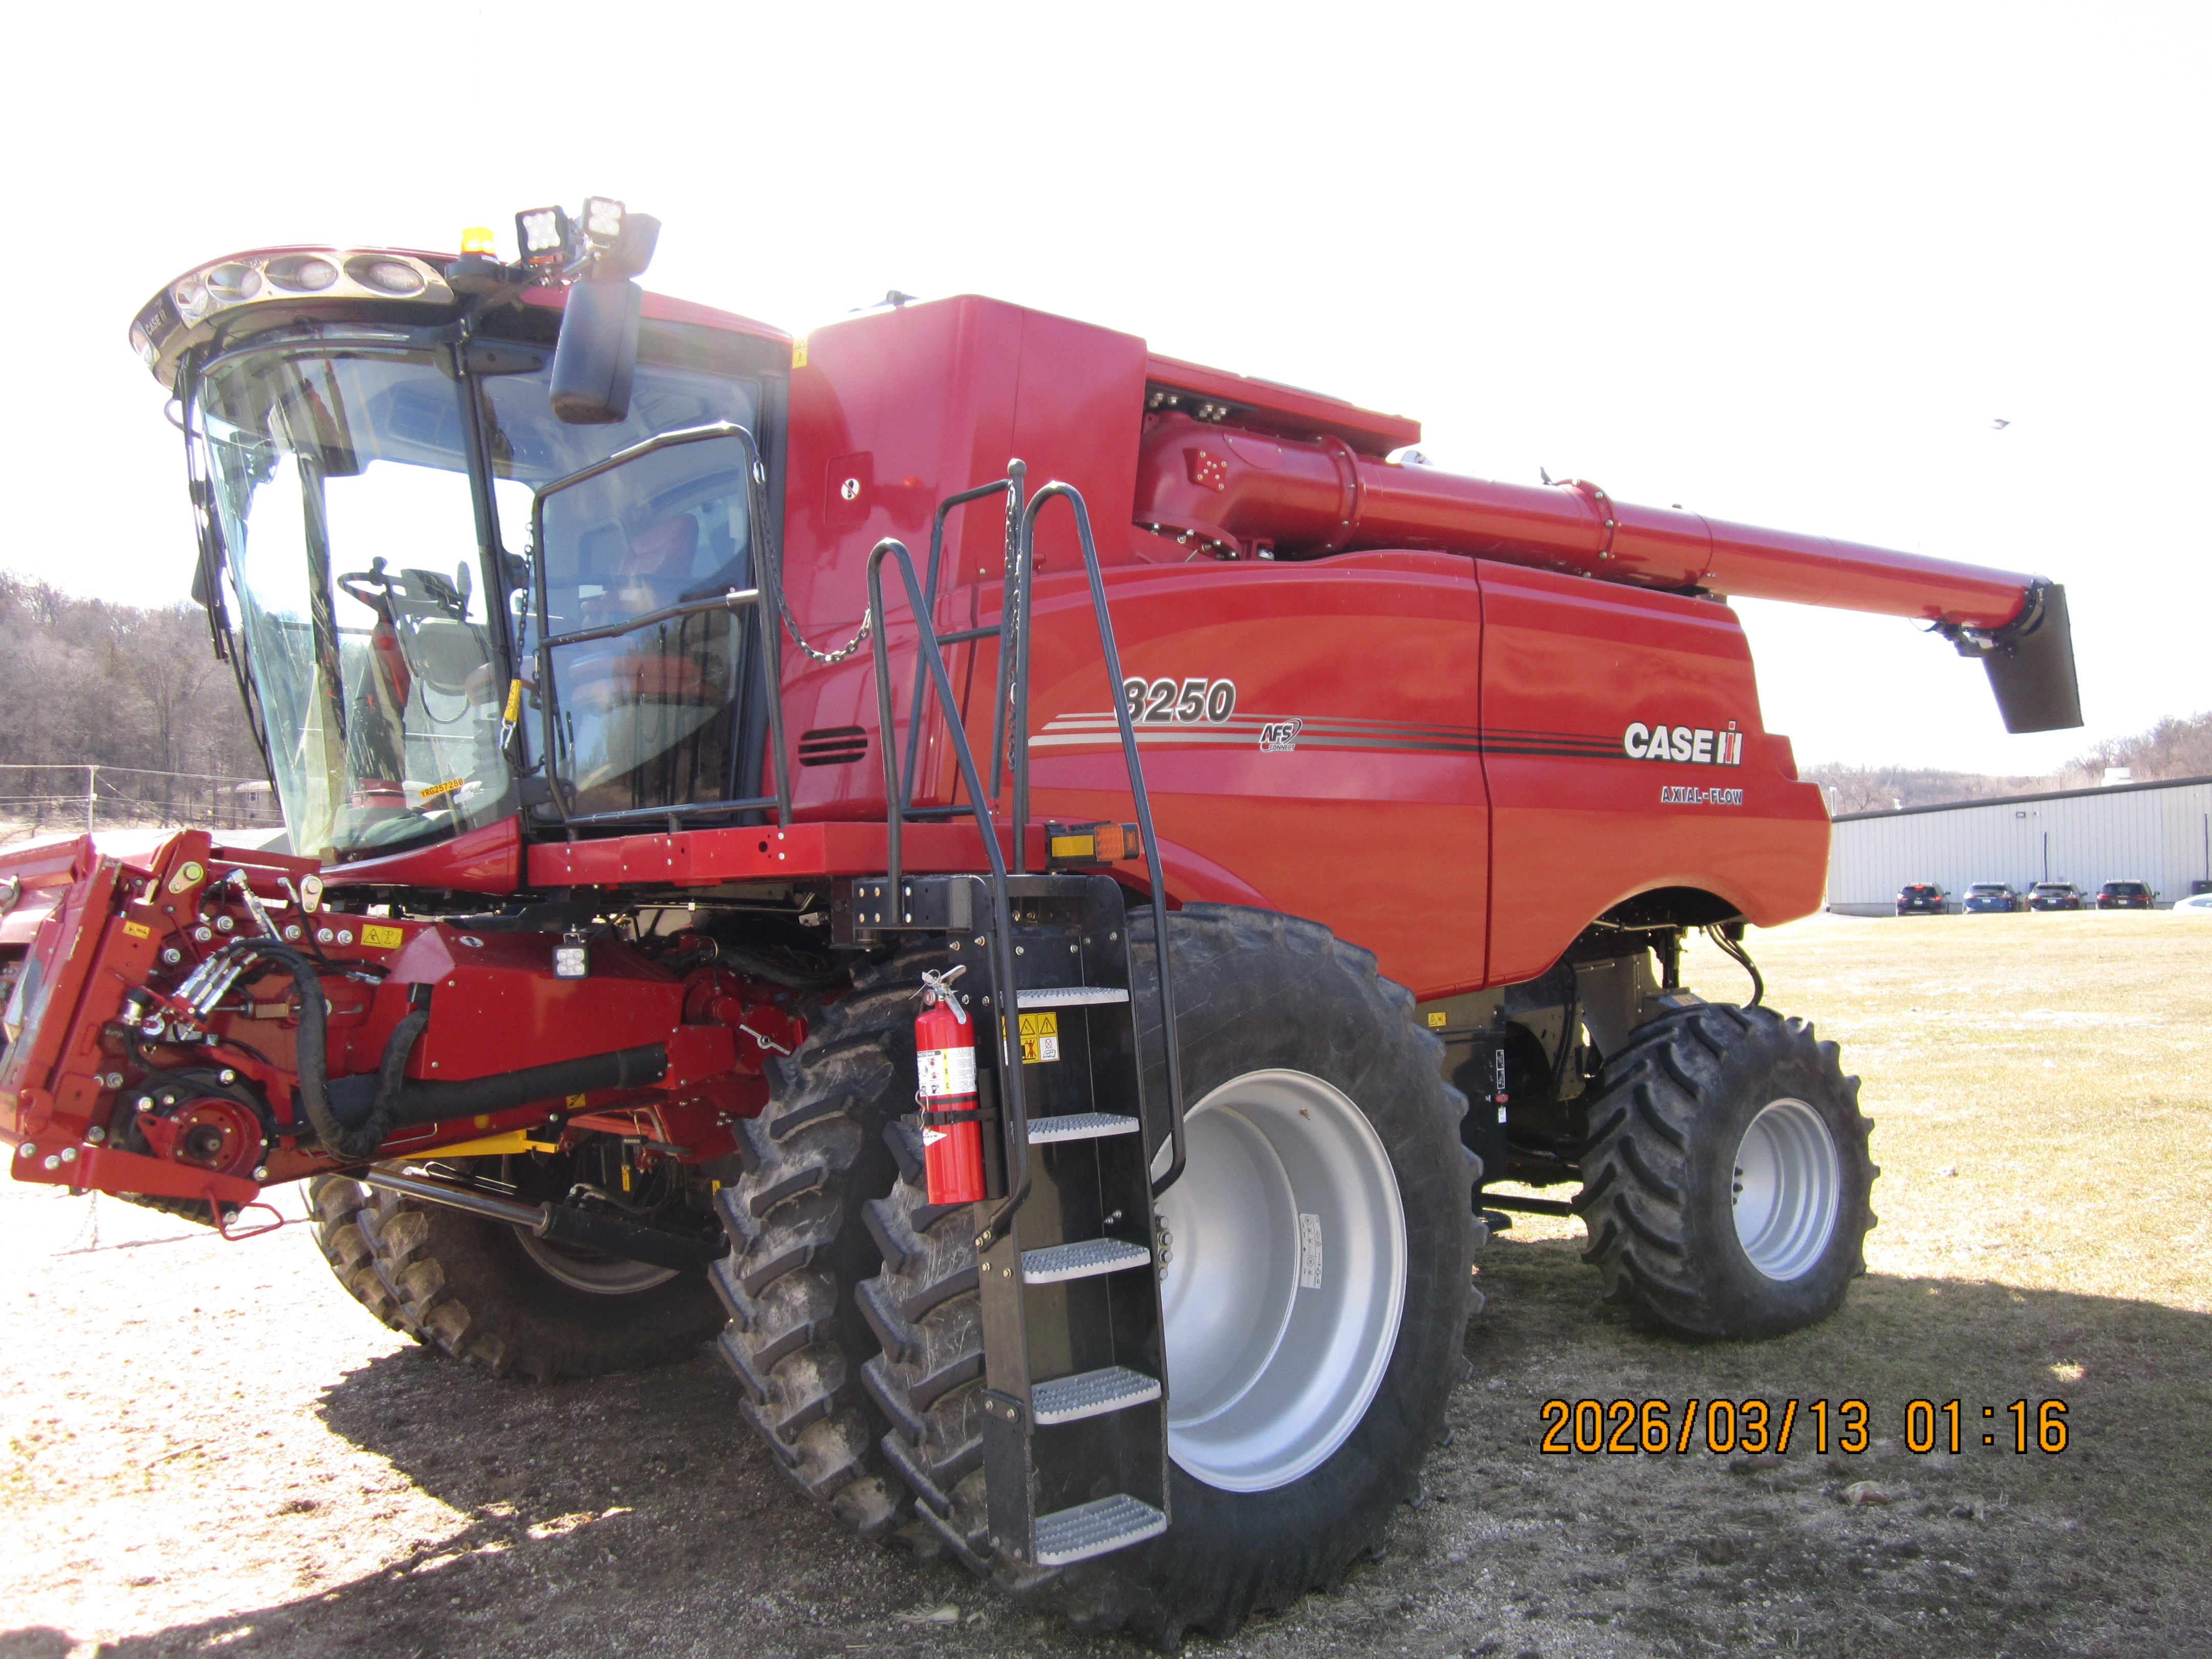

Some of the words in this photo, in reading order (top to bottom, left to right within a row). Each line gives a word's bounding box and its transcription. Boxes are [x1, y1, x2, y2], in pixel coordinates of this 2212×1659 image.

[1114, 676, 1236, 724] 8250
[1259, 723, 1293, 743] AFS
[1624, 721, 1714, 763] CASE
[420, 778, 464, 798] YRG257280
[1661, 786, 1742, 805] AXIAL-FLOW
